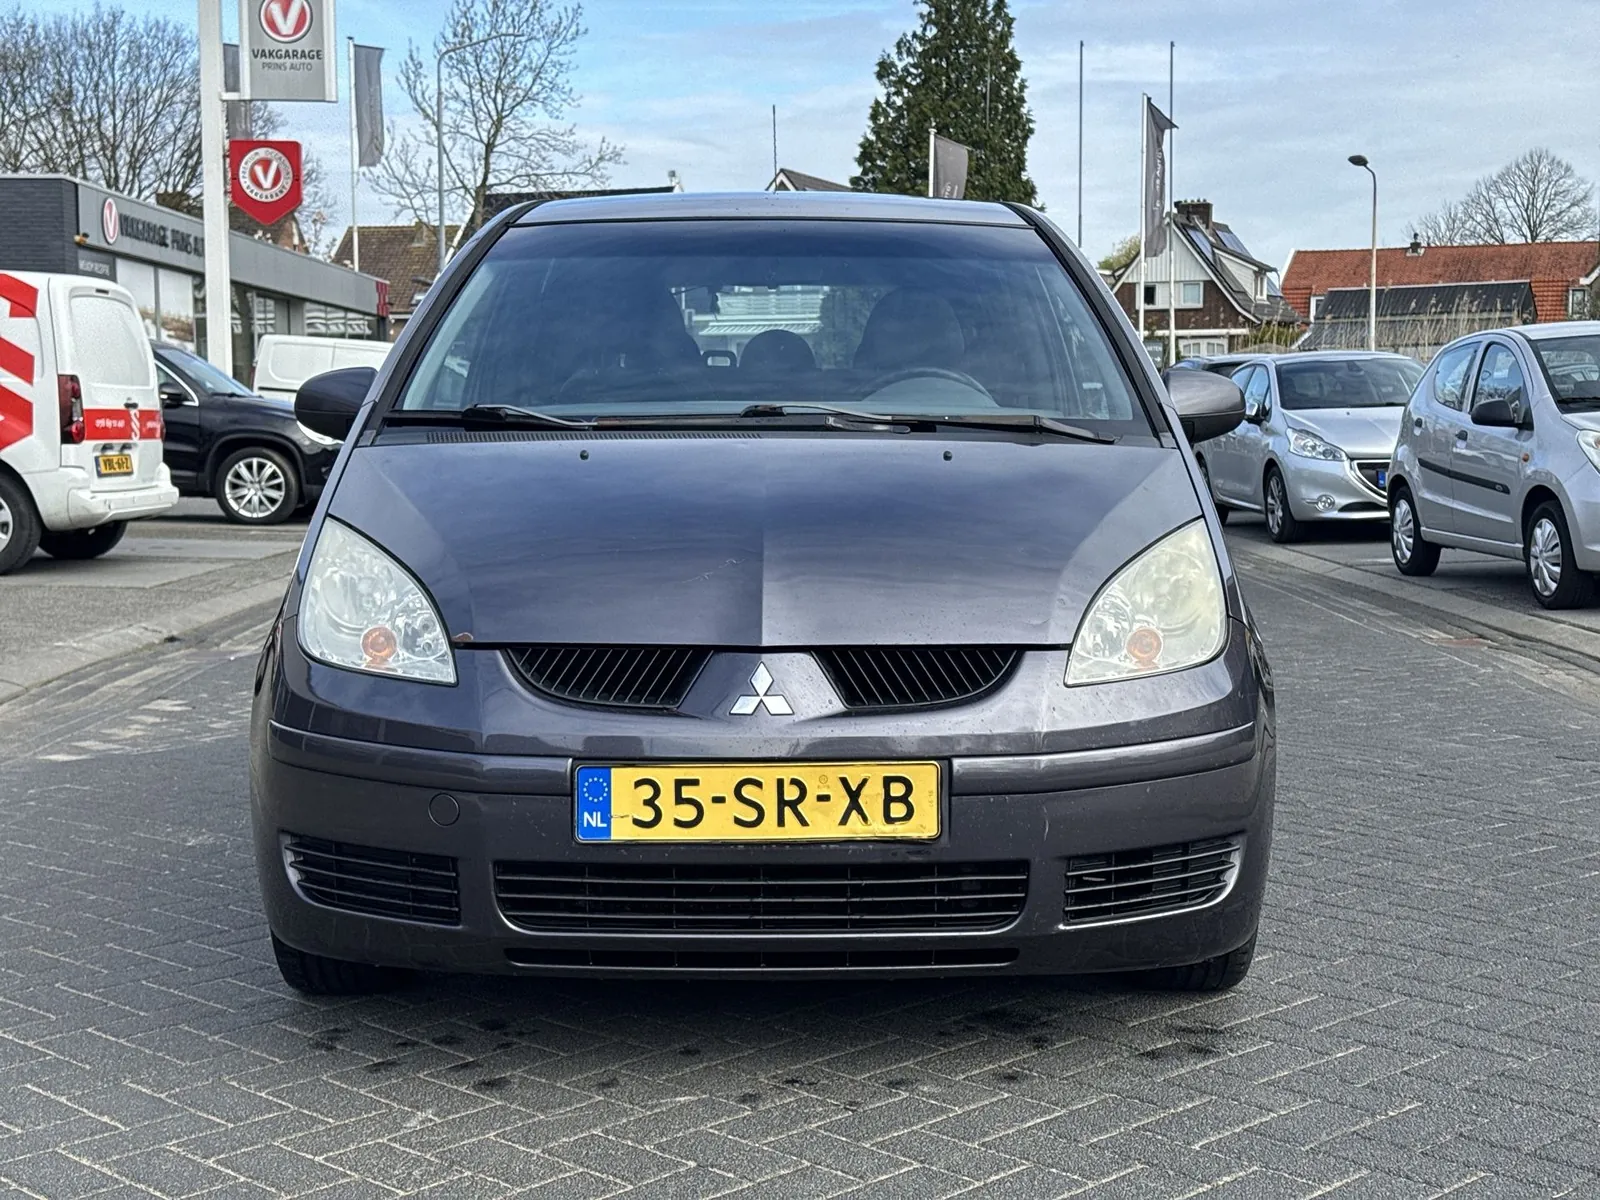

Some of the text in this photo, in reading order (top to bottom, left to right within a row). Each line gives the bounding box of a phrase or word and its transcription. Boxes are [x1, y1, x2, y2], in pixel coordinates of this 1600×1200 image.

[251, 48, 323, 60] VAKGARAGE
[262, 62, 313, 72] PRINS AUTO
[631, 775, 915, 829] 35-SR-XB
[583, 811, 608, 828] NL
